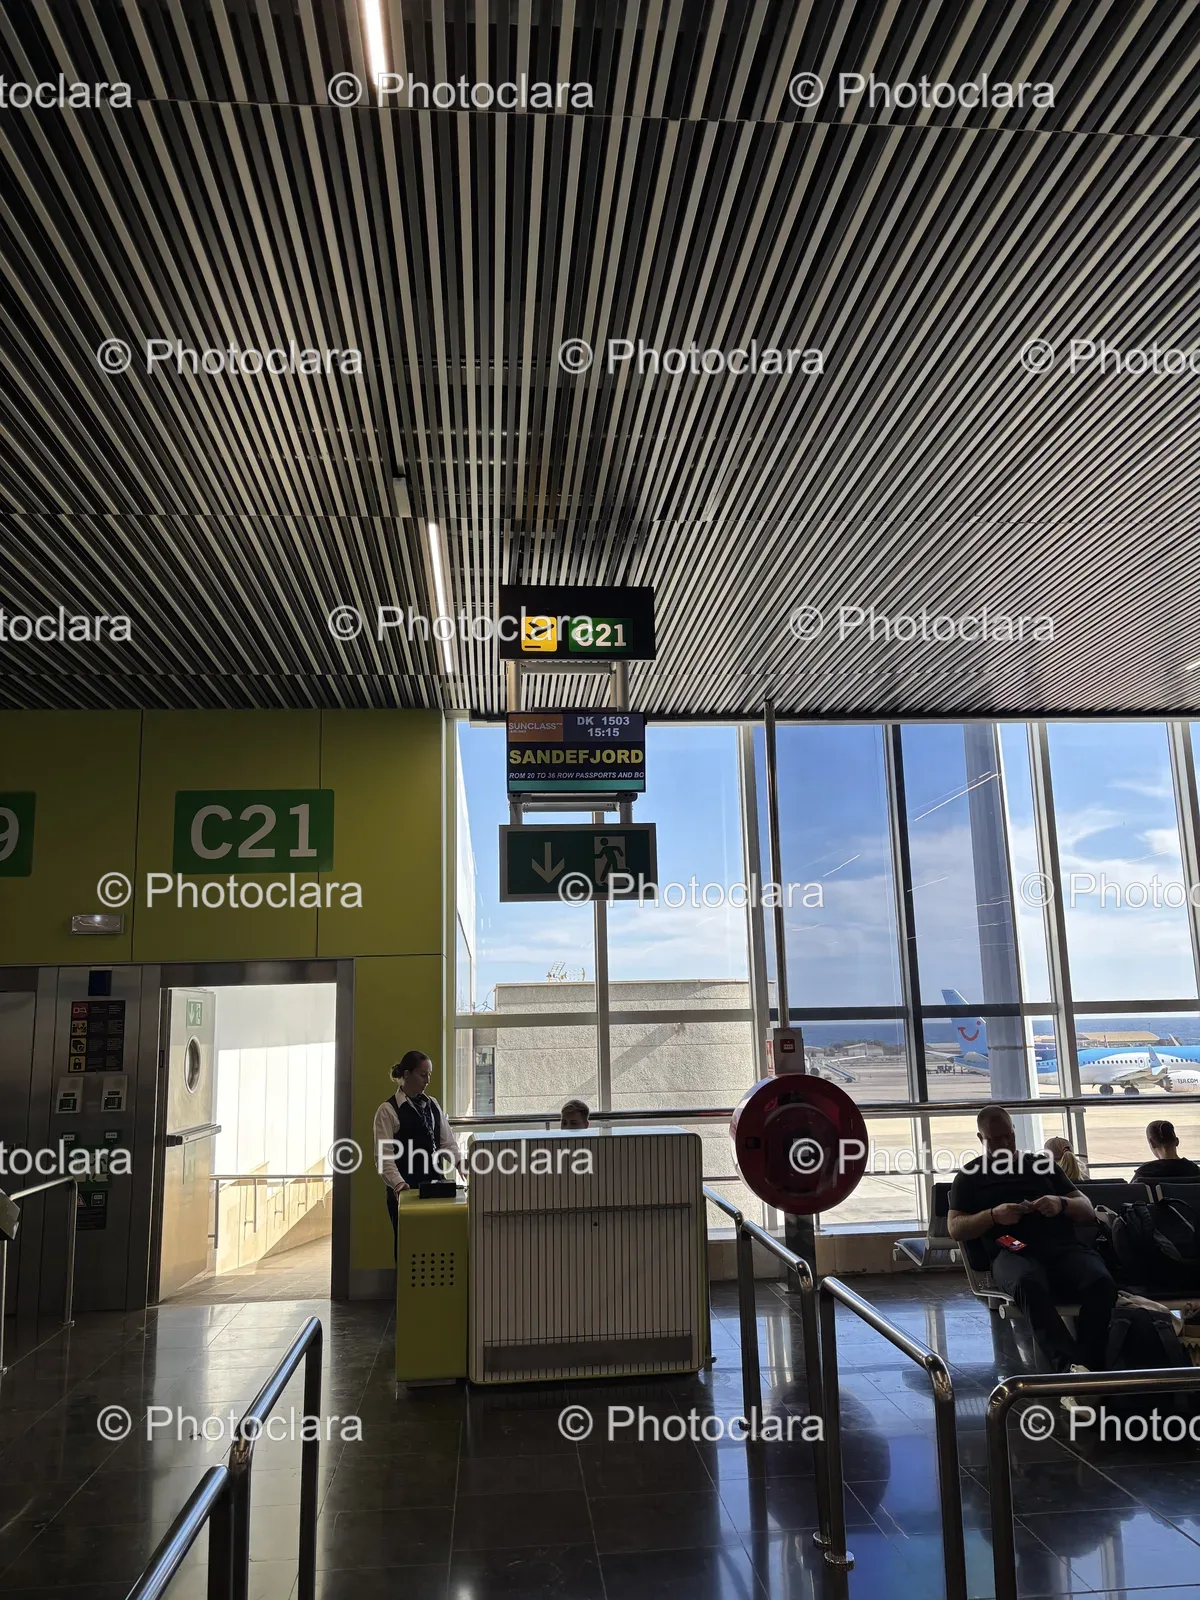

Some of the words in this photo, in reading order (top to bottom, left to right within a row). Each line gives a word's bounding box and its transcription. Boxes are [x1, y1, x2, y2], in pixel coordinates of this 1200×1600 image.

[575, 623, 627, 647] C21
[508, 722, 557, 730] SUNCLASS
[577, 716, 594, 726] DK
[601, 716, 630, 726] 1503
[588, 727, 619, 737] 15:15
[509, 749, 644, 764] SANDEFJORD
[190, 803, 318, 860] C21
